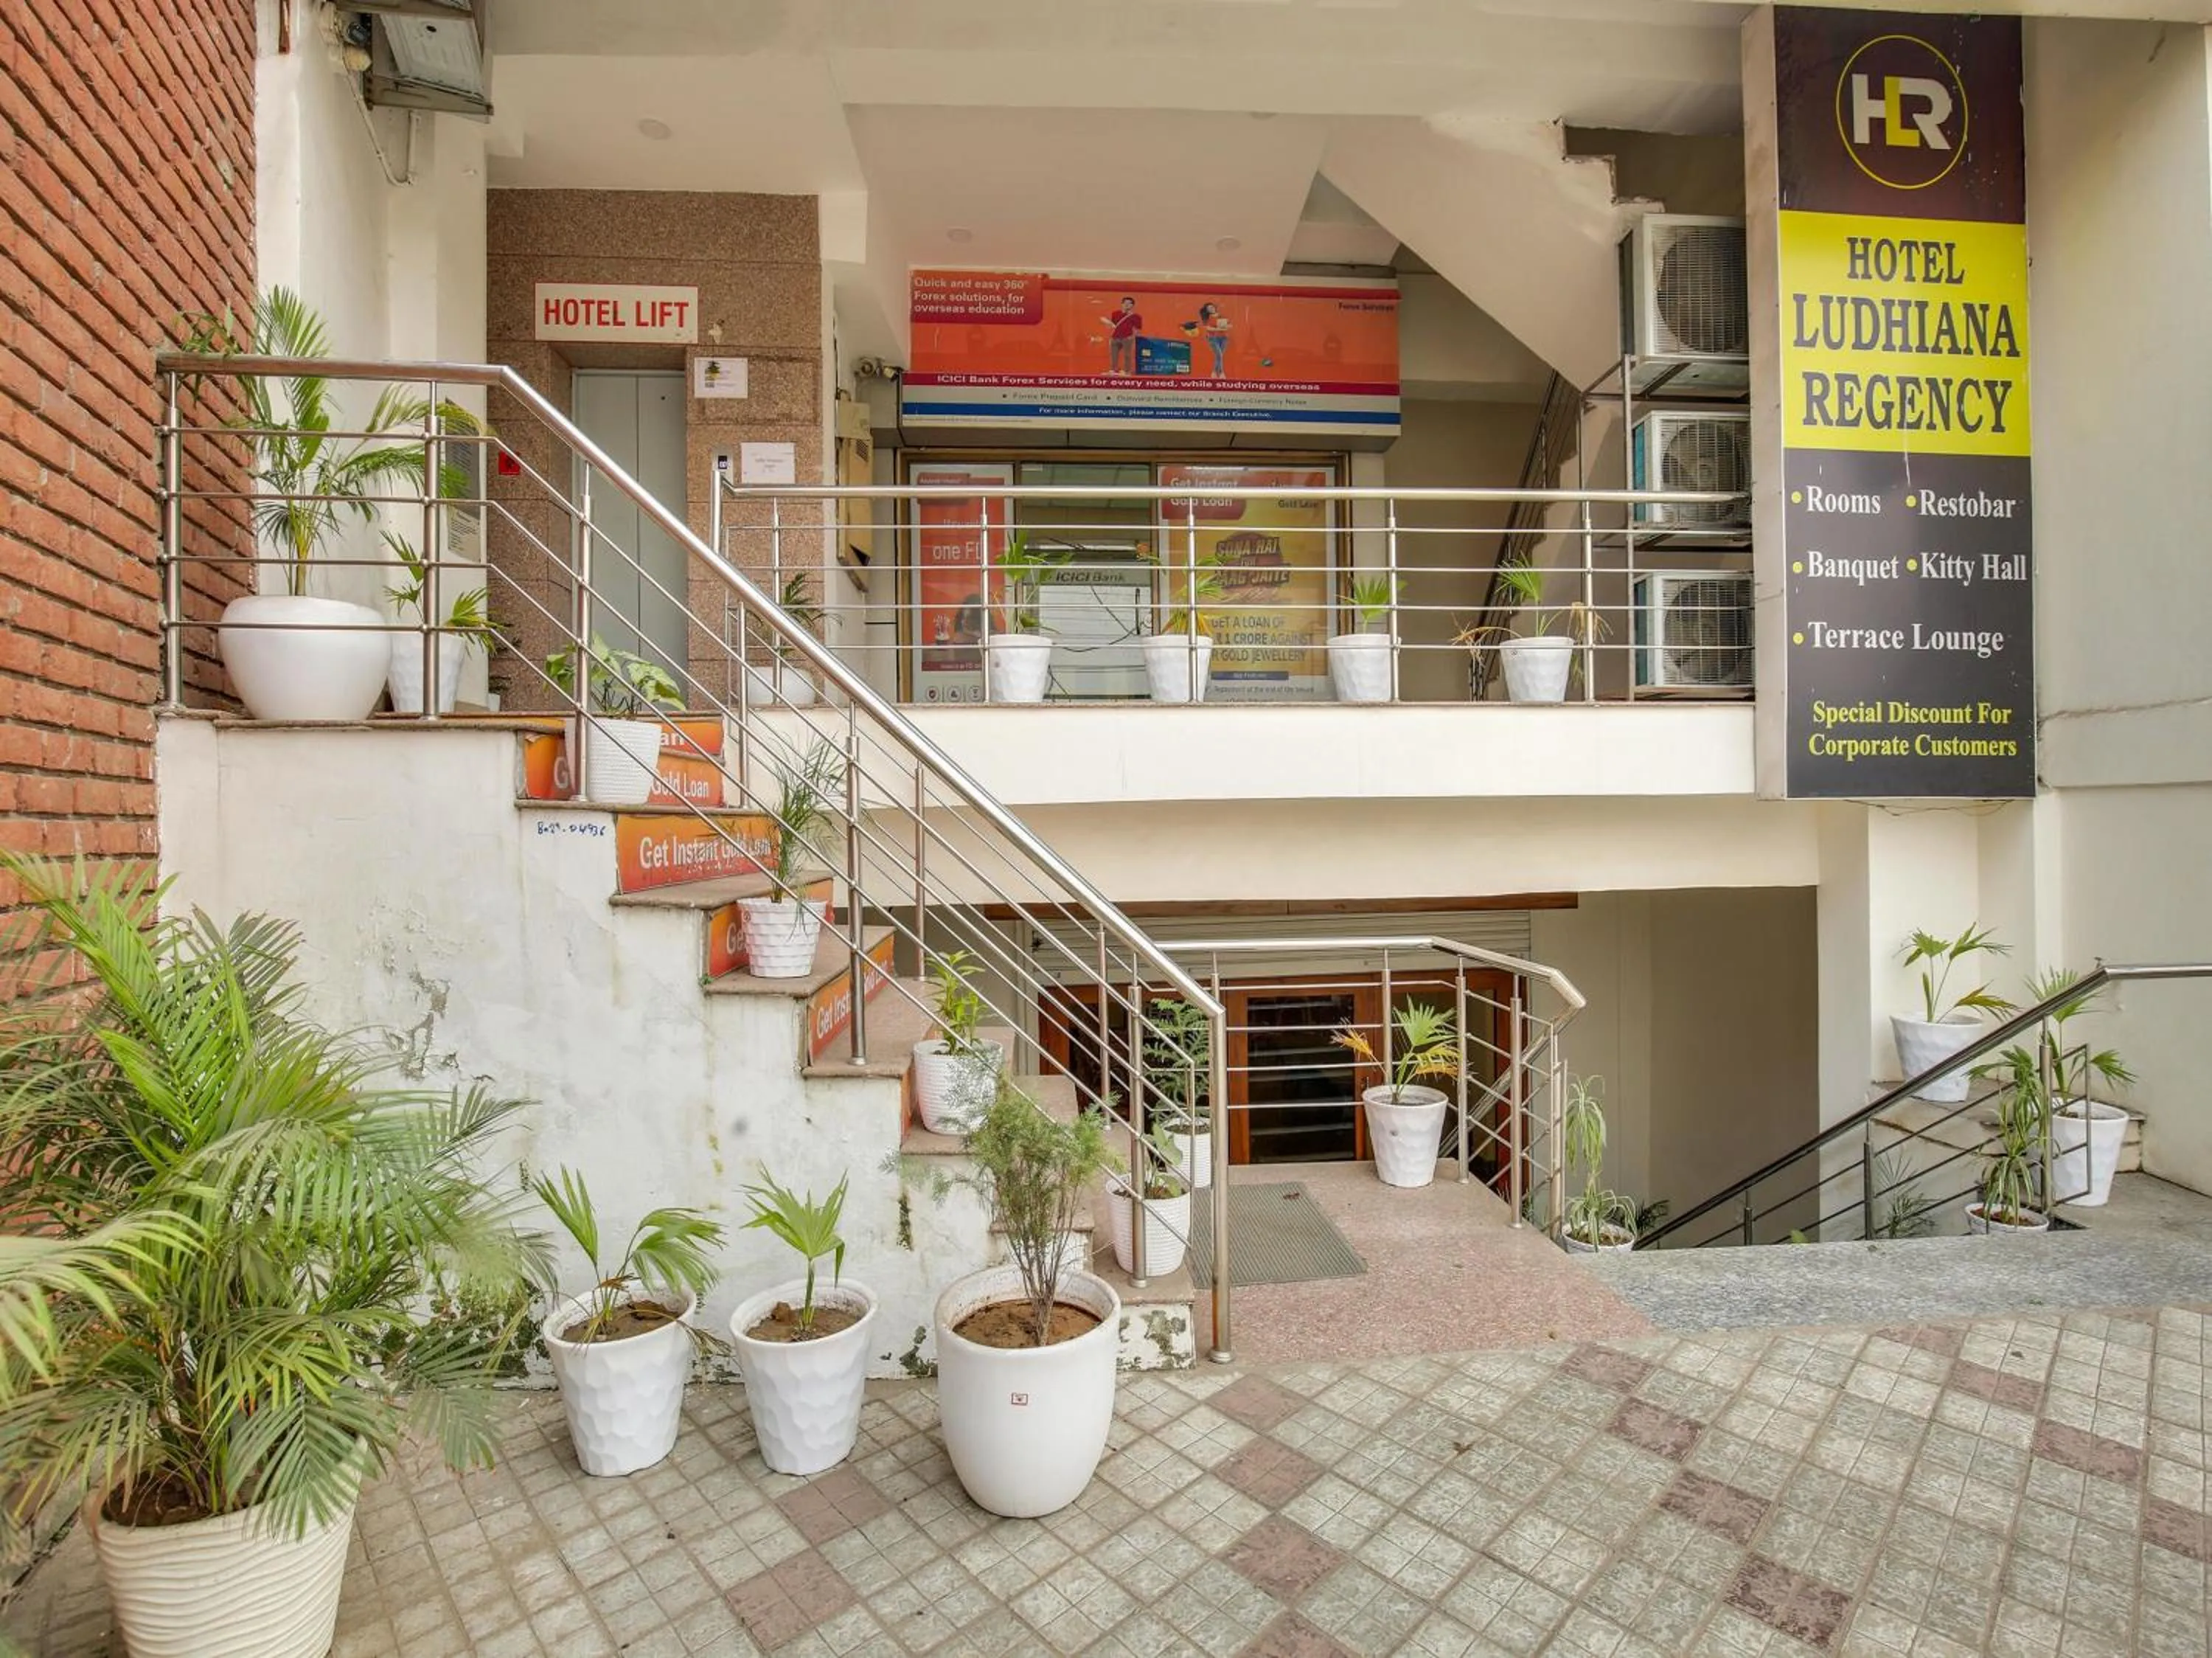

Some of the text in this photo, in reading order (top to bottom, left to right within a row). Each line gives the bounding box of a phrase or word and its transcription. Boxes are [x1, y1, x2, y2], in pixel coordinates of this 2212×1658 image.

[1851, 74, 1952, 150] HLR
[1846, 237, 1965, 285] HOTEL
[914, 277, 946, 288] Quick
[950, 279, 971, 288] and
[975, 281, 1001, 290] easy
[914, 291, 1024, 305] Forex solutions, for
[543, 299, 689, 327] HOTEL LIFT
[914, 302, 1024, 315] overseas education
[1792, 293, 2020, 358] LUDHIANA
[937, 375, 965, 384] ICICI
[970, 375, 998, 384] Bank
[1002, 376, 1034, 385] Forex
[1038, 377, 1088, 386] Services
[1091, 378, 1107, 386] for
[1110, 380, 1142, 389] every
[1180, 380, 1212, 389] while
[1217, 381, 1266, 391] studying
[1270, 384, 1321, 392] overseas
[1802, 371, 2013, 434] REGENCY
[1806, 485, 1881, 514] Rooms
[1919, 489, 2017, 518] Restobar
[933, 544, 961, 561] one
[1056, 572, 1125, 583] ICICI Bank
[1807, 550, 1900, 586] Banquet
[1920, 552, 2028, 586] Kitty Hall
[1243, 616, 1270, 628] LOAN
[1234, 633, 1267, 645] CRORE
[1807, 622, 2005, 659] Terrace Lounge
[1251, 648, 1307, 664] JEWELLERY
[1812, 701, 2012, 729] Special Discount For
[1809, 733, 2017, 762] Corporate Customers
[684, 773, 709, 798] Loan
[639, 836, 669, 869] Get
[672, 835, 719, 865] Instant
[726, 921, 747, 954] Ge
[816, 1002, 833, 1038] Get
